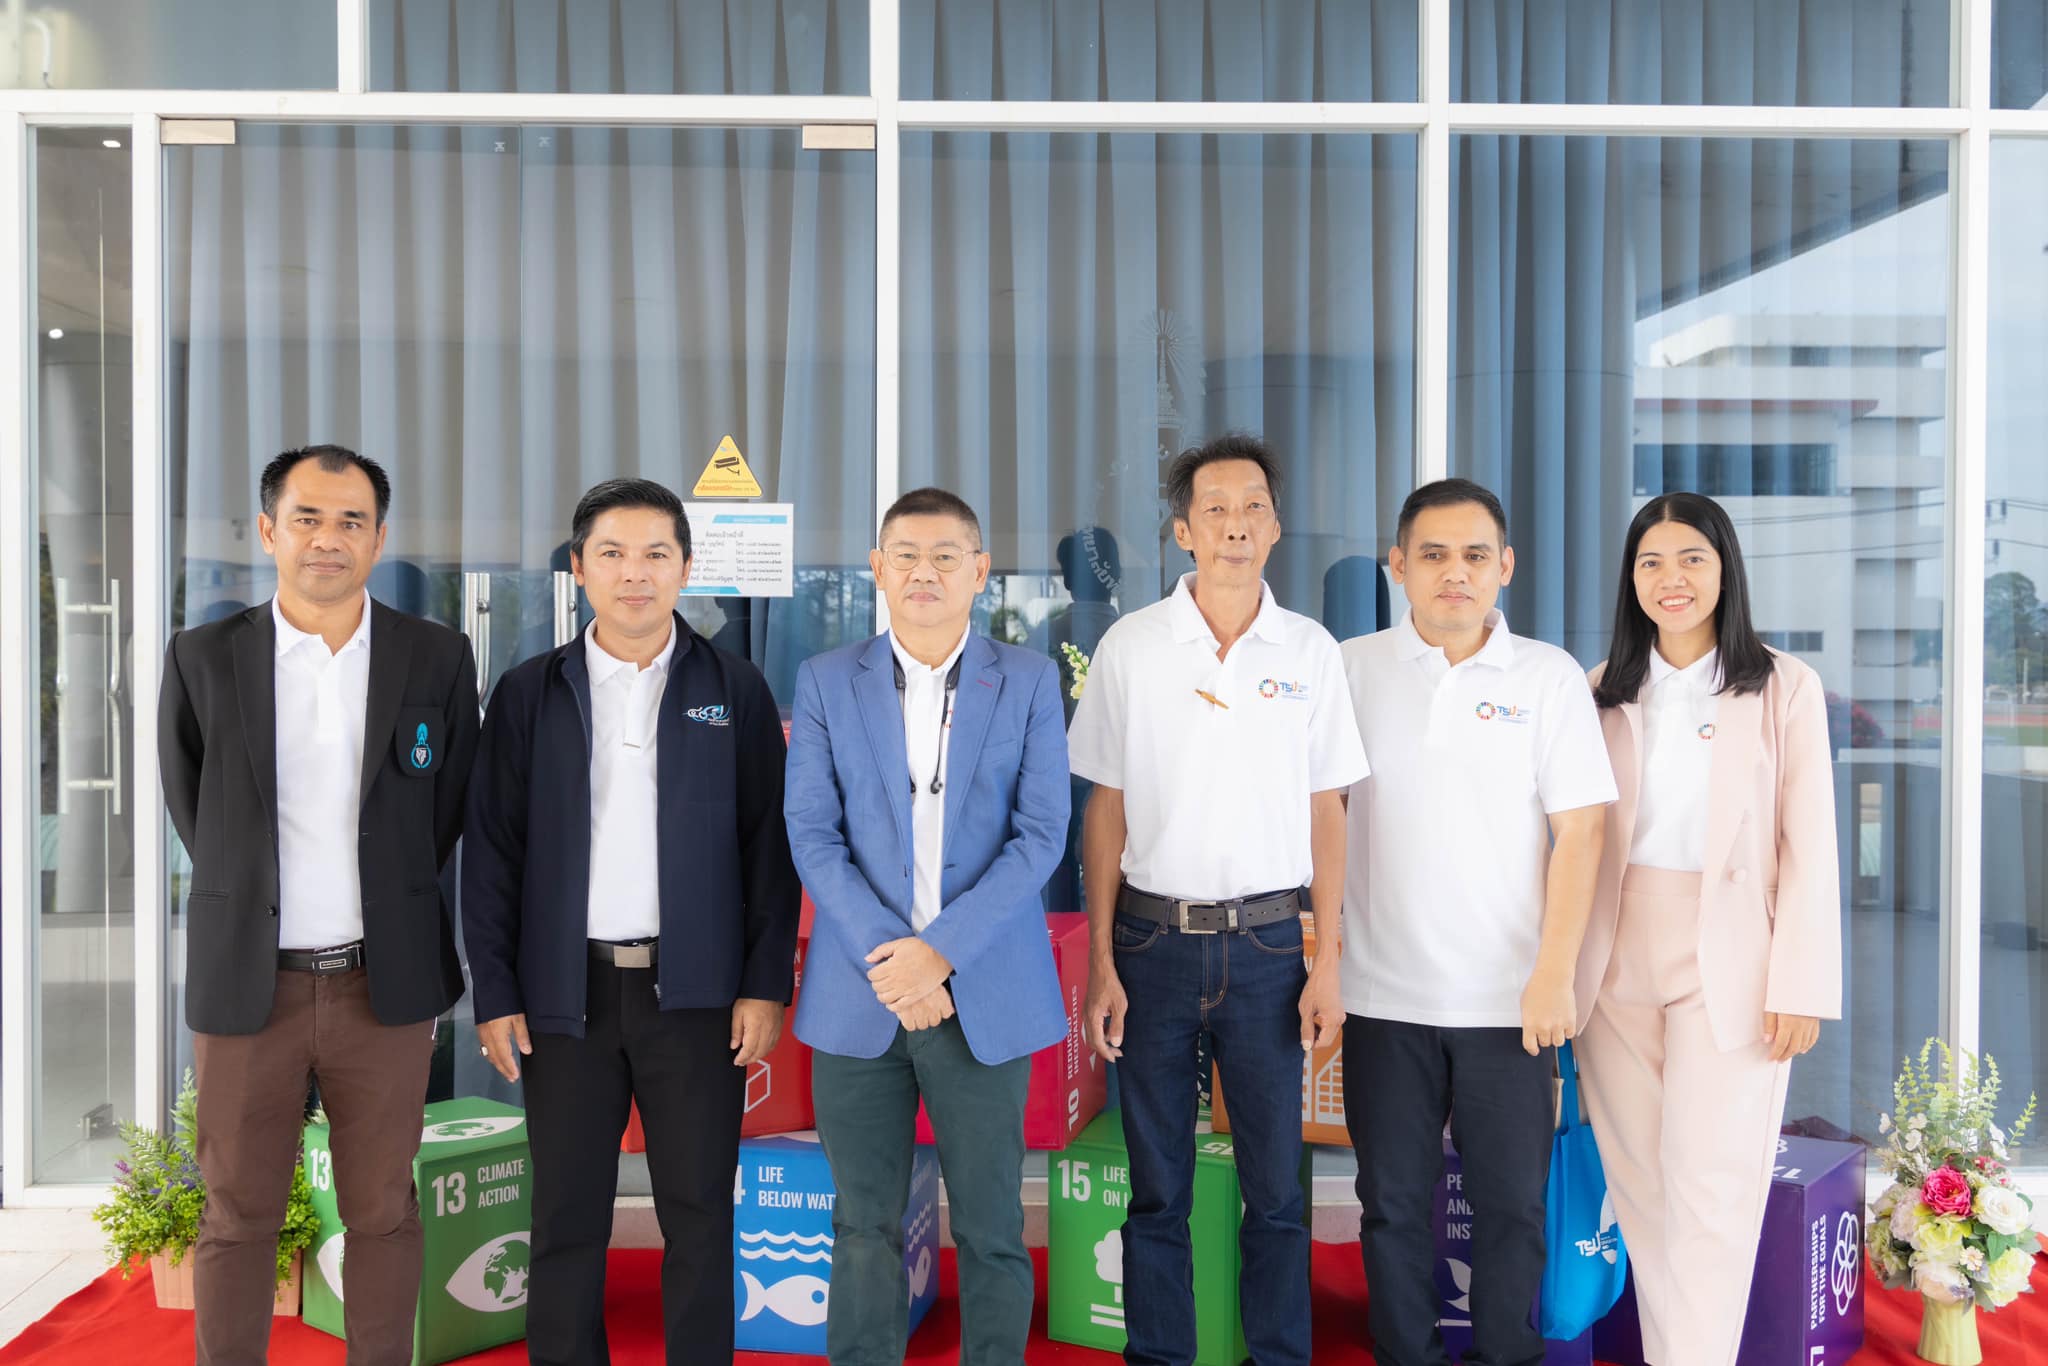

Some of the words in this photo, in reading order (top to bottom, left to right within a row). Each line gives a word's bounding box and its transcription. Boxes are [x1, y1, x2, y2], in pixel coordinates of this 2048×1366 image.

[1068, 1087, 1079, 1132] 10
[310, 1148, 331, 1192] 13
[477, 1158, 525, 1184] CLIMATE
[733, 1164, 746, 1205] 4
[758, 1166, 784, 1184] LIFE
[1057, 1159, 1092, 1202] 15
[1103, 1165, 1127, 1184] LIFE
[431, 1171, 467, 1217] 13
[477, 1183, 519, 1209] ACTION
[758, 1190, 803, 1209] BELOW
[806, 1192, 837, 1211] WAT
[1103, 1189, 1120, 1207] ON
[1575, 1230, 1601, 1257] TSU
[1819, 1214, 1827, 1262] GOALS
[1810, 1219, 1819, 1331] PARTNERSHIPS
[1818, 1294, 1826, 1324] FOR
